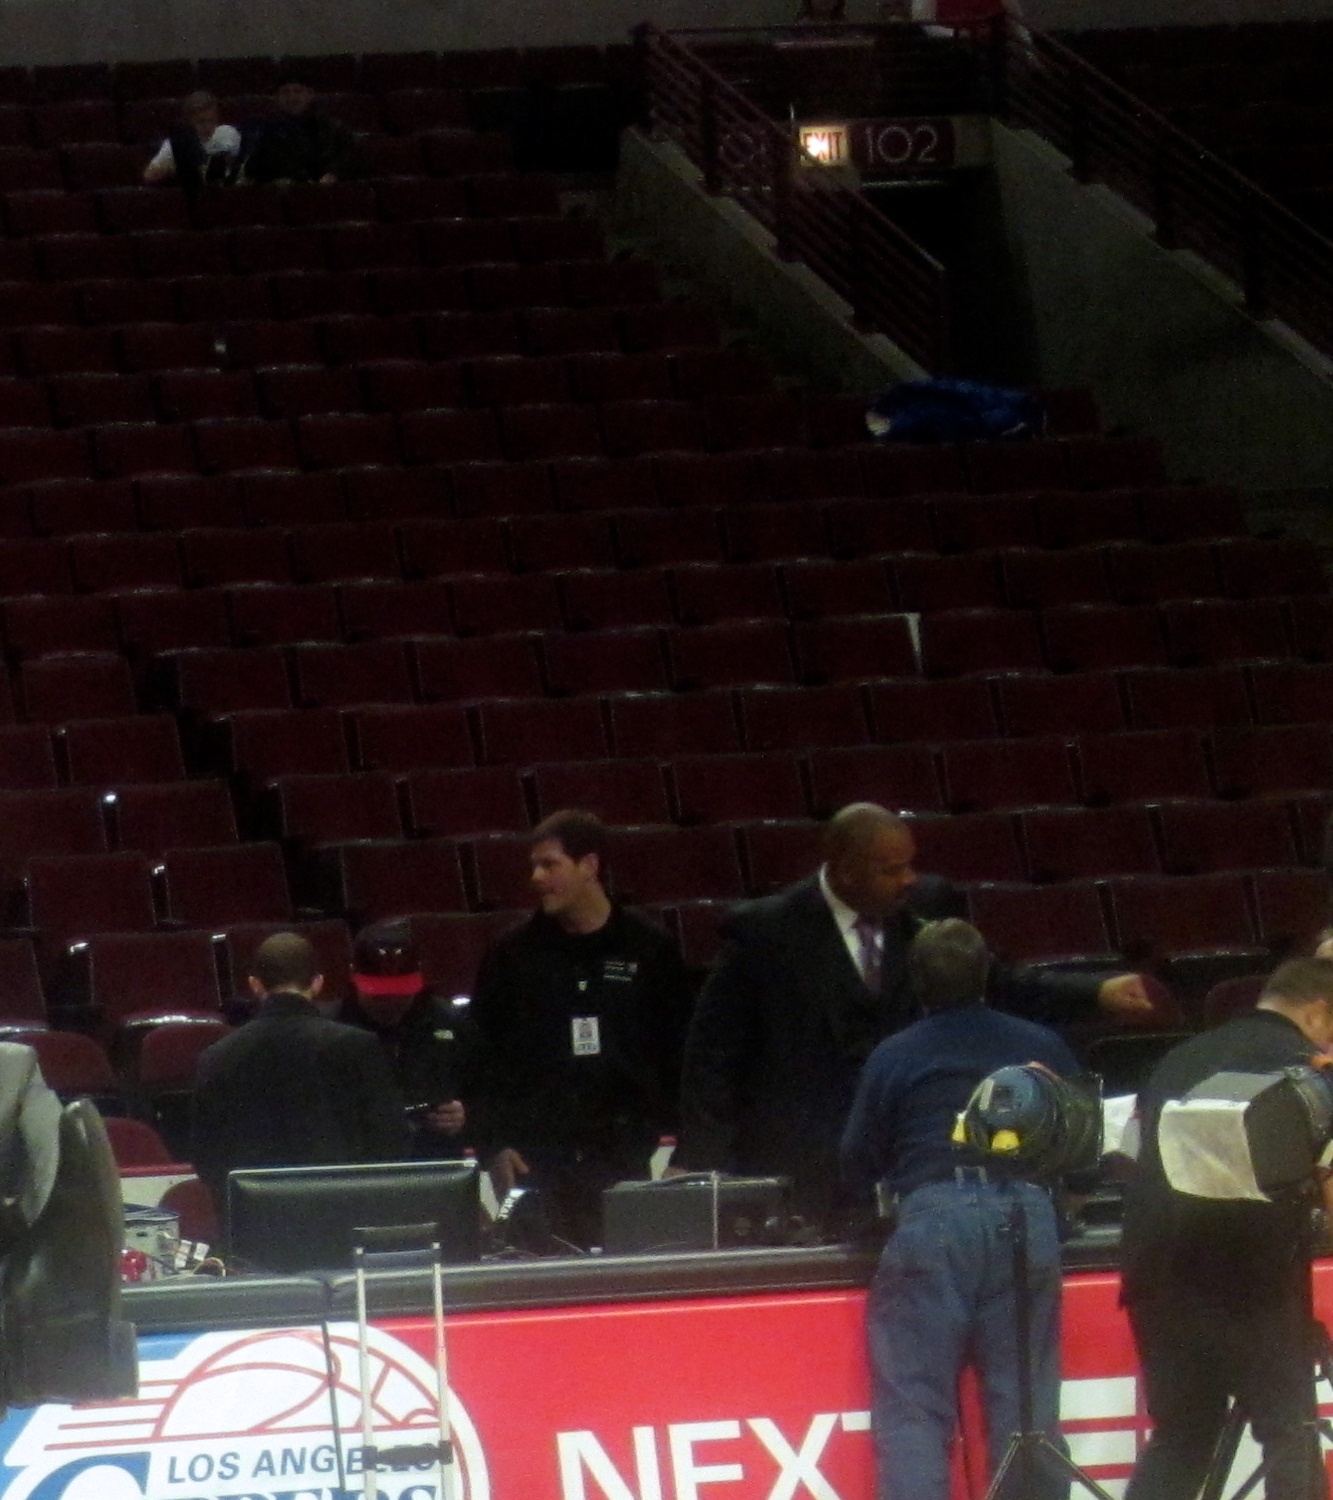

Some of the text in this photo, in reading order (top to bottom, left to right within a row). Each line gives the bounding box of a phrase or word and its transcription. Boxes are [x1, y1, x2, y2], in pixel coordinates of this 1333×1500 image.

[803, 131, 843, 160] EXIT
[864, 124, 938, 165] 102
[166, 1441, 435, 1485] LOS ANGE
